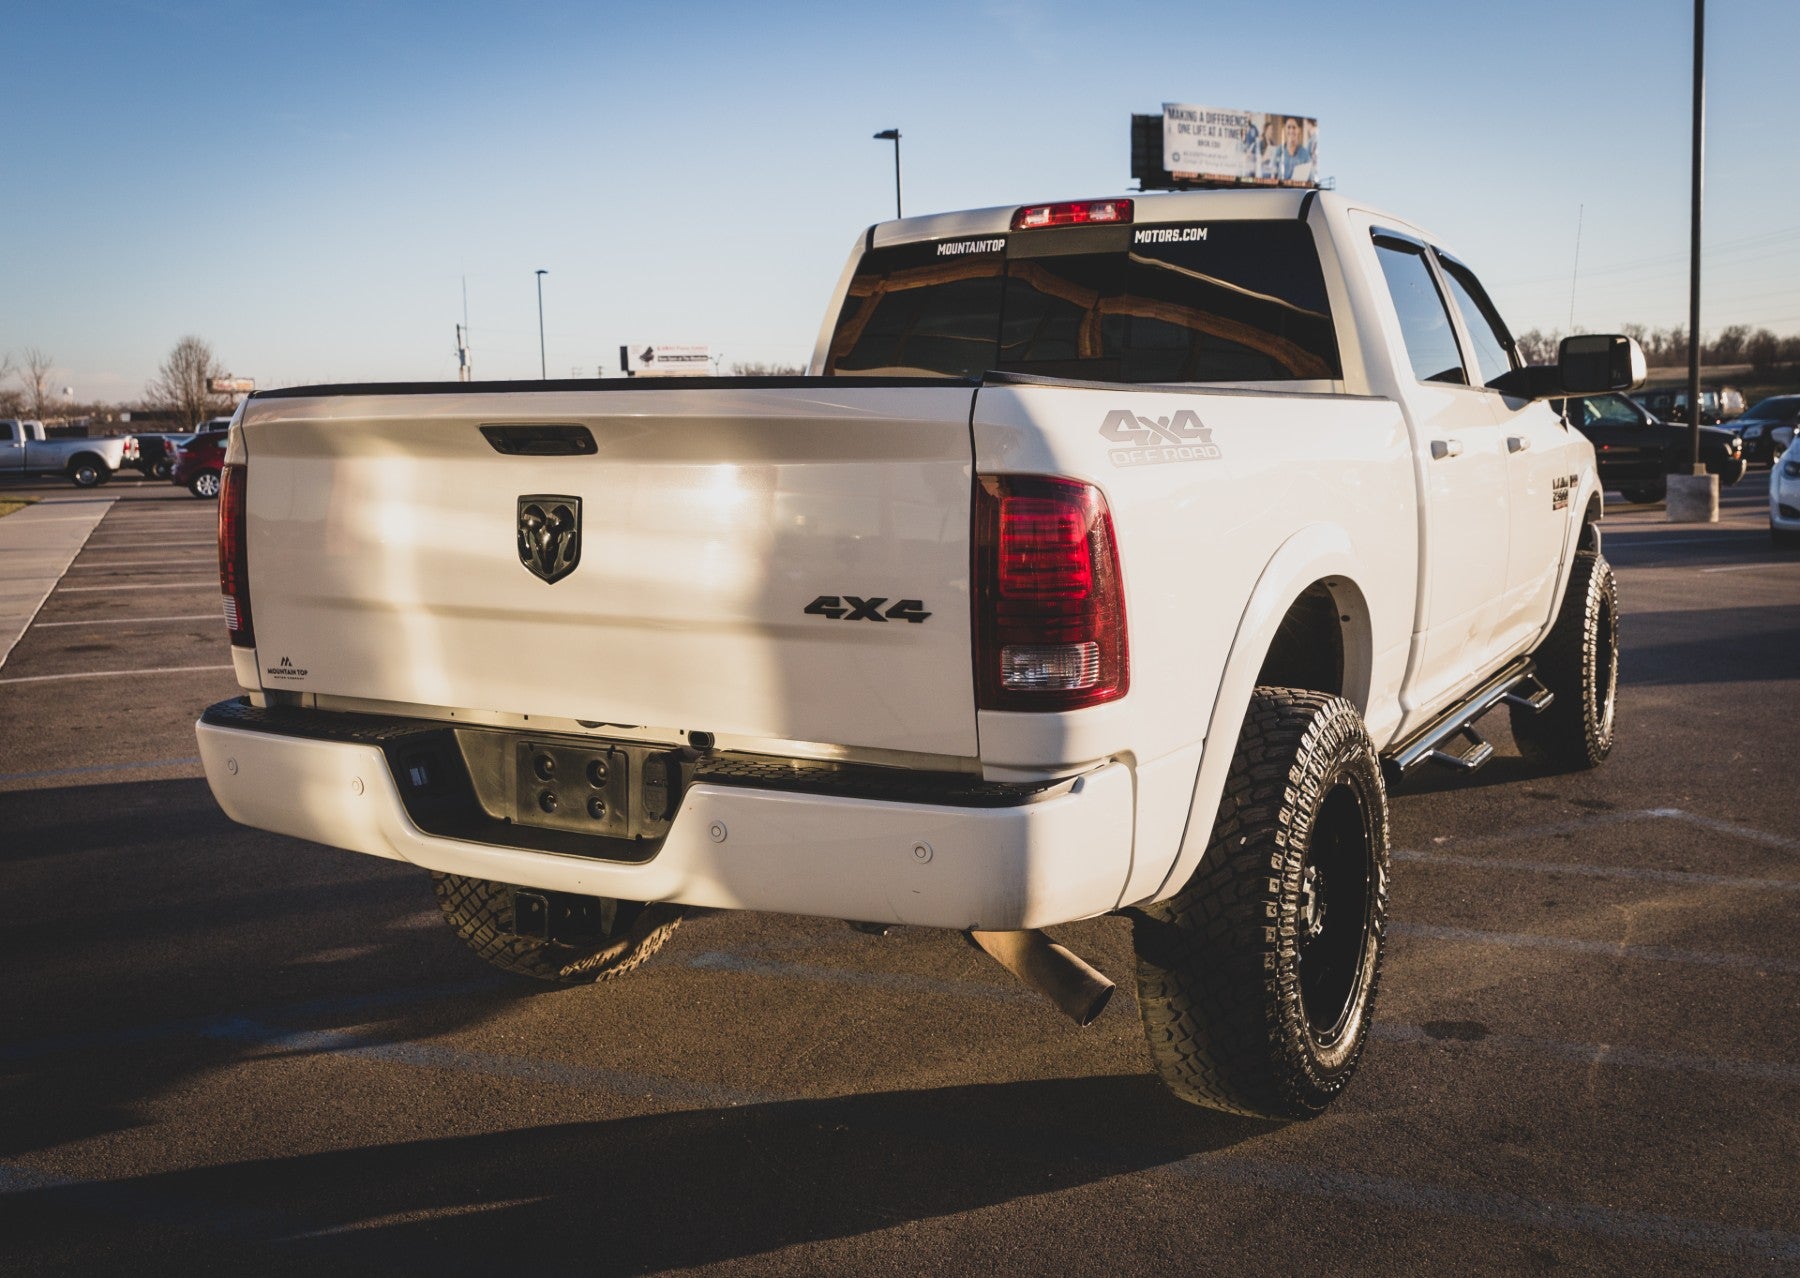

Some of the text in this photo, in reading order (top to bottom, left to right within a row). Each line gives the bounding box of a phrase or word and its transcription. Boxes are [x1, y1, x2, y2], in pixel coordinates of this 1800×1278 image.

[1168, 108, 1197, 122] MAKING
[1199, 111, 1204, 122] A
[1177, 123, 1191, 134] ONE
[1193, 124, 1207, 136] LIFE
[1208, 126, 1216, 136] AT
[1218, 127, 1223, 137] A
[1135, 228, 1208, 243] MOTORS.COM
[937, 239, 1005, 255] MOUNTAINTOP
[1111, 445, 1219, 465] OFF ROAD
[804, 595, 932, 623] 4X4
[267, 667, 296, 676] MOUNTAIN
